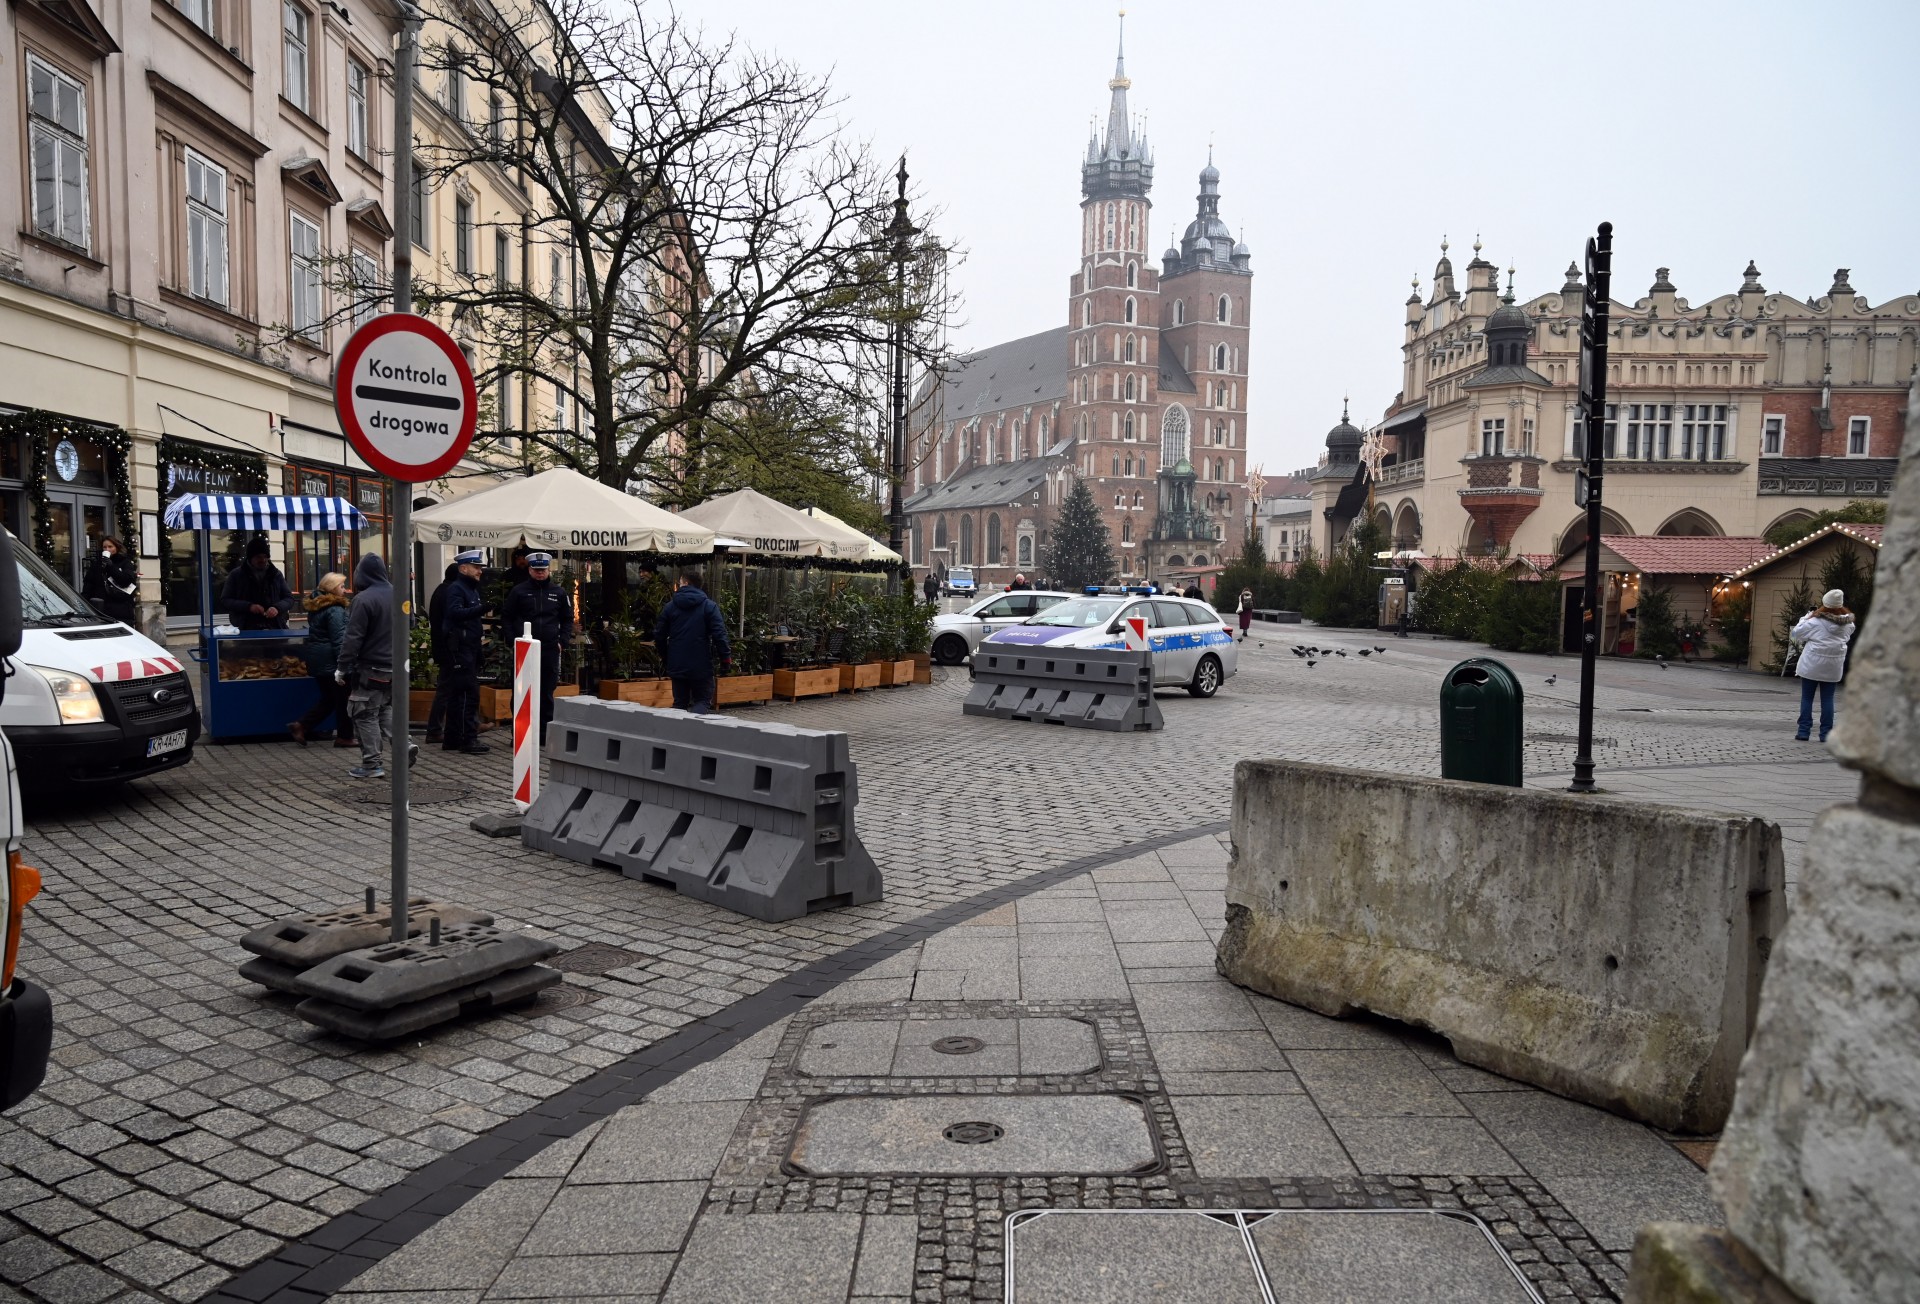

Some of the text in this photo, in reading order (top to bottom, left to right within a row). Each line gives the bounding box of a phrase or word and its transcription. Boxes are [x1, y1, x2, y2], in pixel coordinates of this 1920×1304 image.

[369, 358, 448, 387] Kontrola
[369, 410, 449, 437] drogowa
[456, 529, 500, 539] NAKIELNY
[570, 529, 628, 547] OKOCIM
[677, 537, 704, 545] NAKIELNY
[754, 537, 800, 552] OKOCIM
